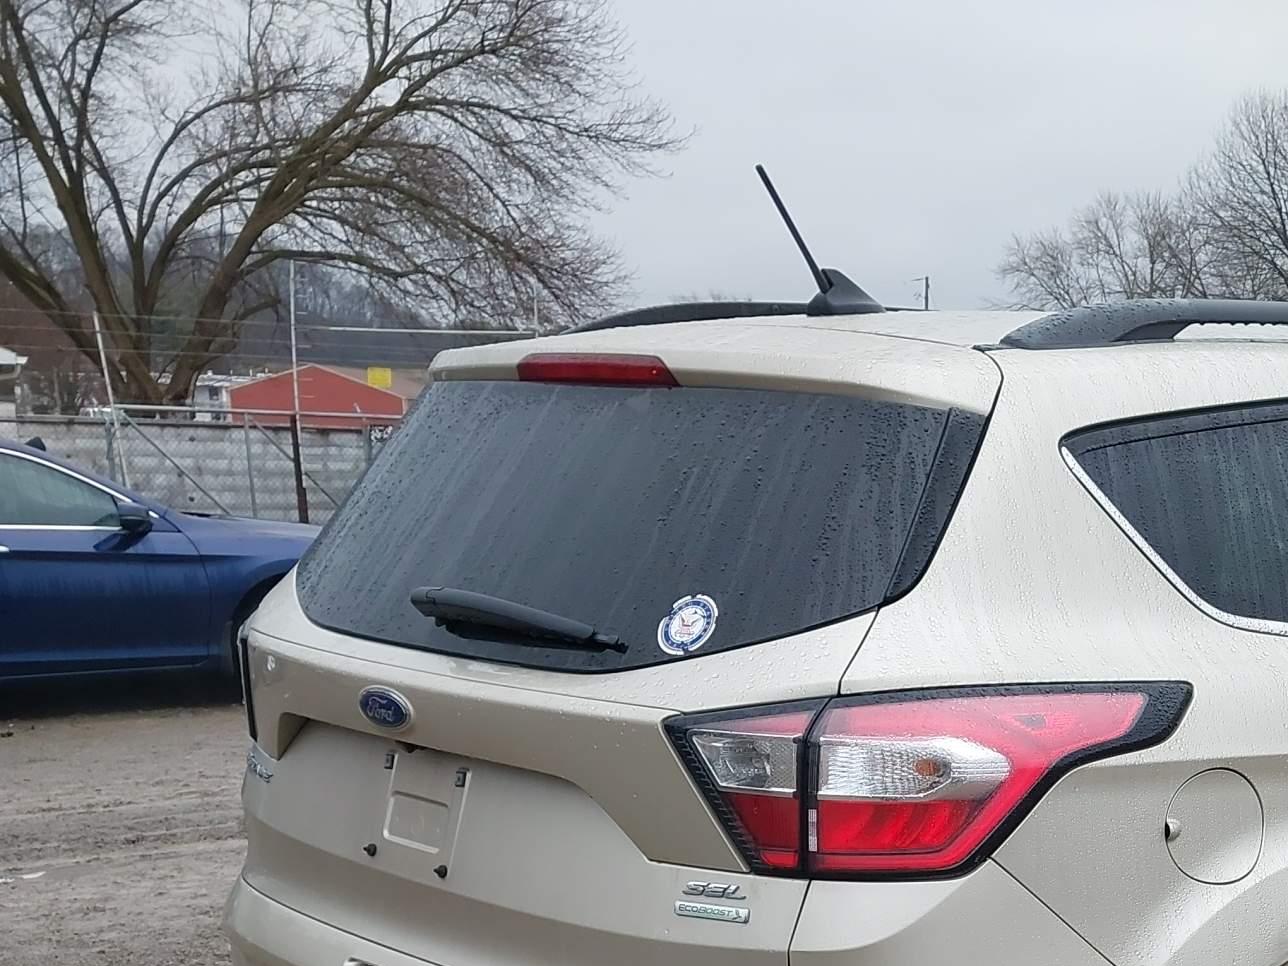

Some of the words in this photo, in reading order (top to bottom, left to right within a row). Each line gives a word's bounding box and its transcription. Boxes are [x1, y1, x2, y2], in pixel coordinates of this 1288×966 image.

[367, 696, 394, 722] Ford
[682, 881, 747, 900] SEL
[678, 903, 734, 917] ECOBOOST
